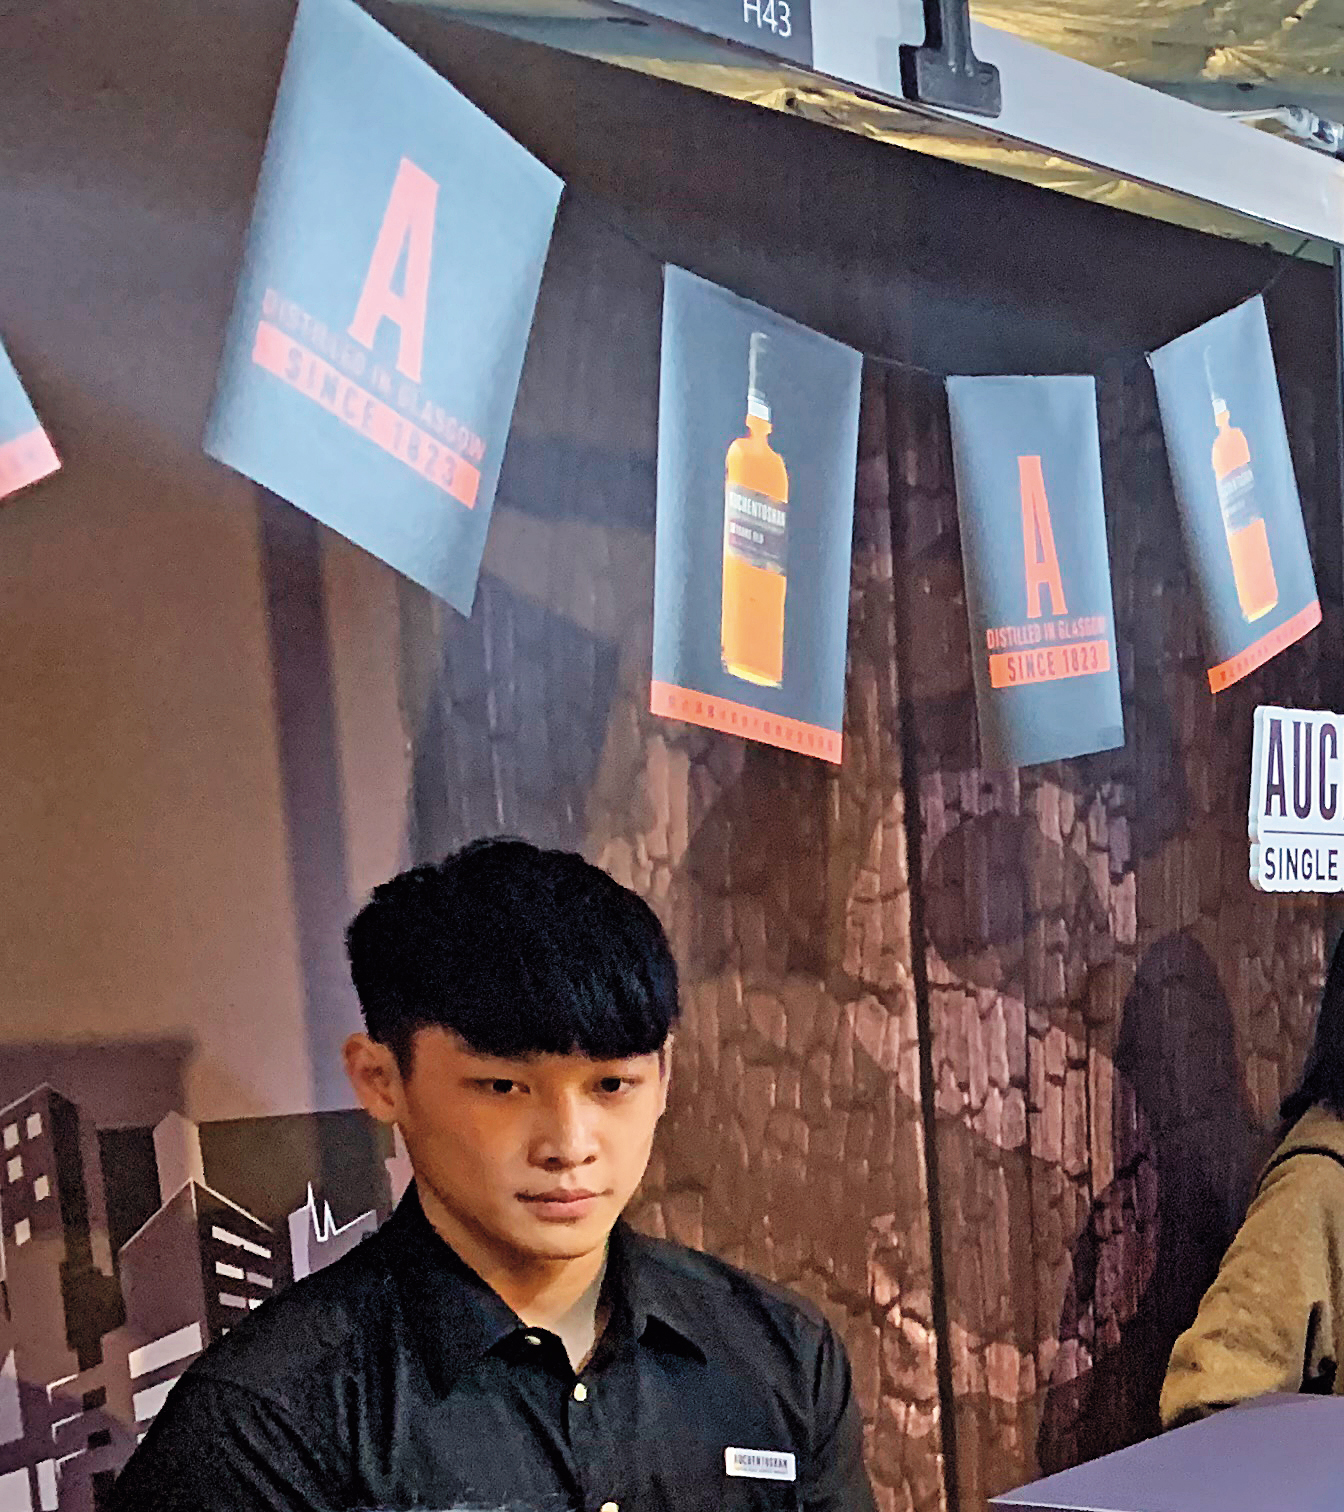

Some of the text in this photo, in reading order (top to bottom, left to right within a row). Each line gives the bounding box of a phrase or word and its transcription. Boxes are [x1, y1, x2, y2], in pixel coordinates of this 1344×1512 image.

[743, 0, 792, 37] H43
[347, 155, 440, 385] A
[283, 345, 376, 431] SINCE
[1018, 455, 1068, 618] A
[986, 621, 1041, 649] DISTILLED
[1007, 646, 1098, 682] SINCE 1823
[1264, 847, 1339, 882] SINGLE
